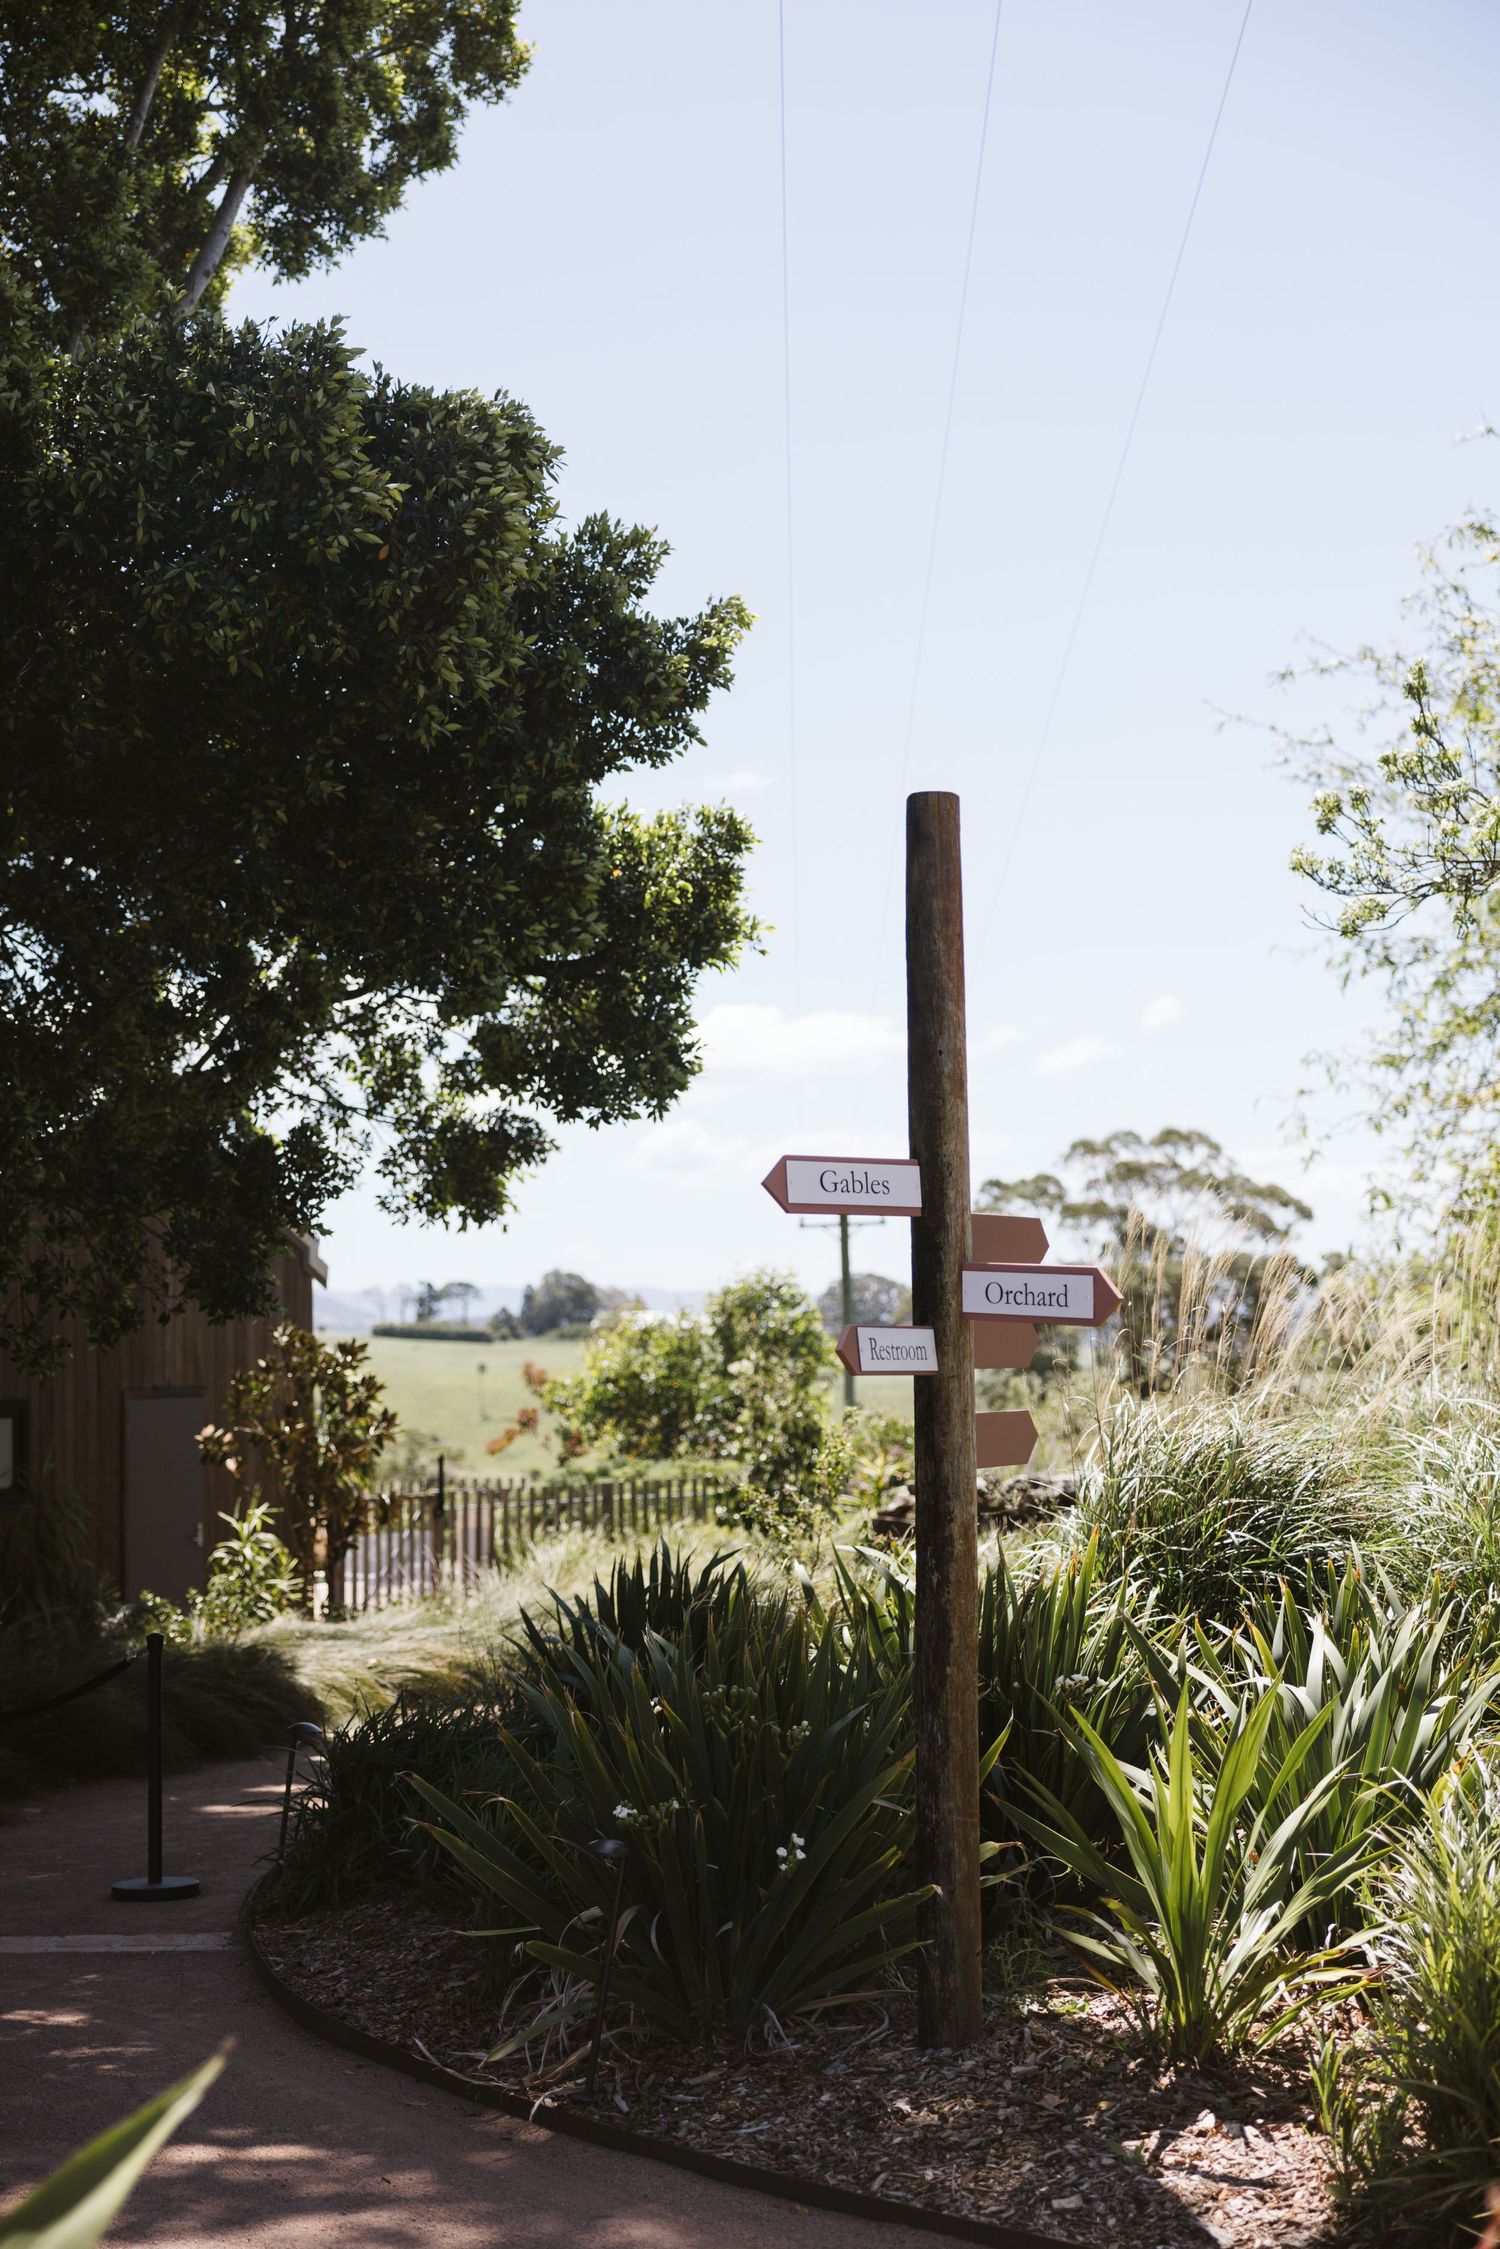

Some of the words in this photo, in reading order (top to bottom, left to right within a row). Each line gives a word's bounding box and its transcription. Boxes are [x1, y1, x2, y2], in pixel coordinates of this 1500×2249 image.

[819, 1169, 891, 1195] Gables
[984, 1281, 1069, 1308] Orchard
[868, 1337, 928, 1361] Restroom
